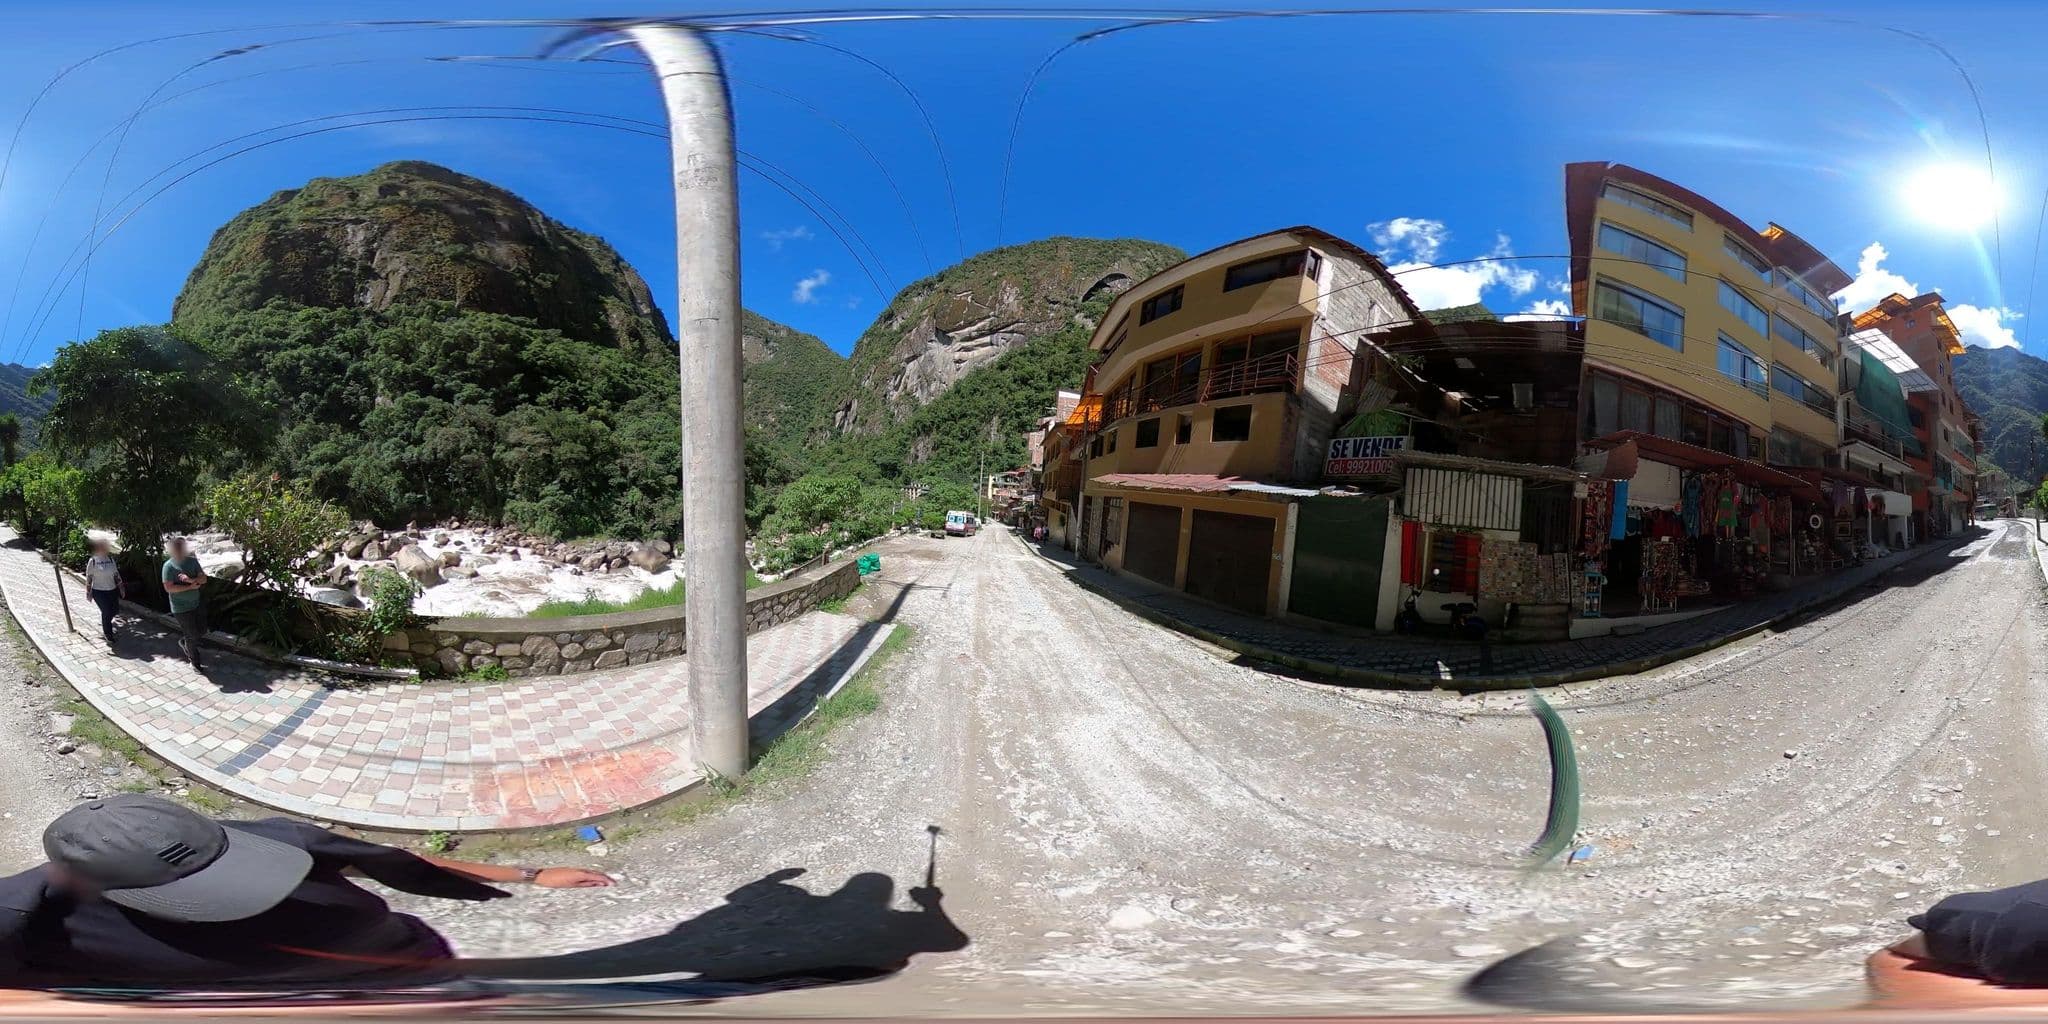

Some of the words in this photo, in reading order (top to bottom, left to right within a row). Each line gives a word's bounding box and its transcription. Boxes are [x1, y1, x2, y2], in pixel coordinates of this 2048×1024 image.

[1331, 439, 1350, 458] SE
[1328, 460, 1345, 474] Cel:
[1346, 459, 1393, 474] 99921009
